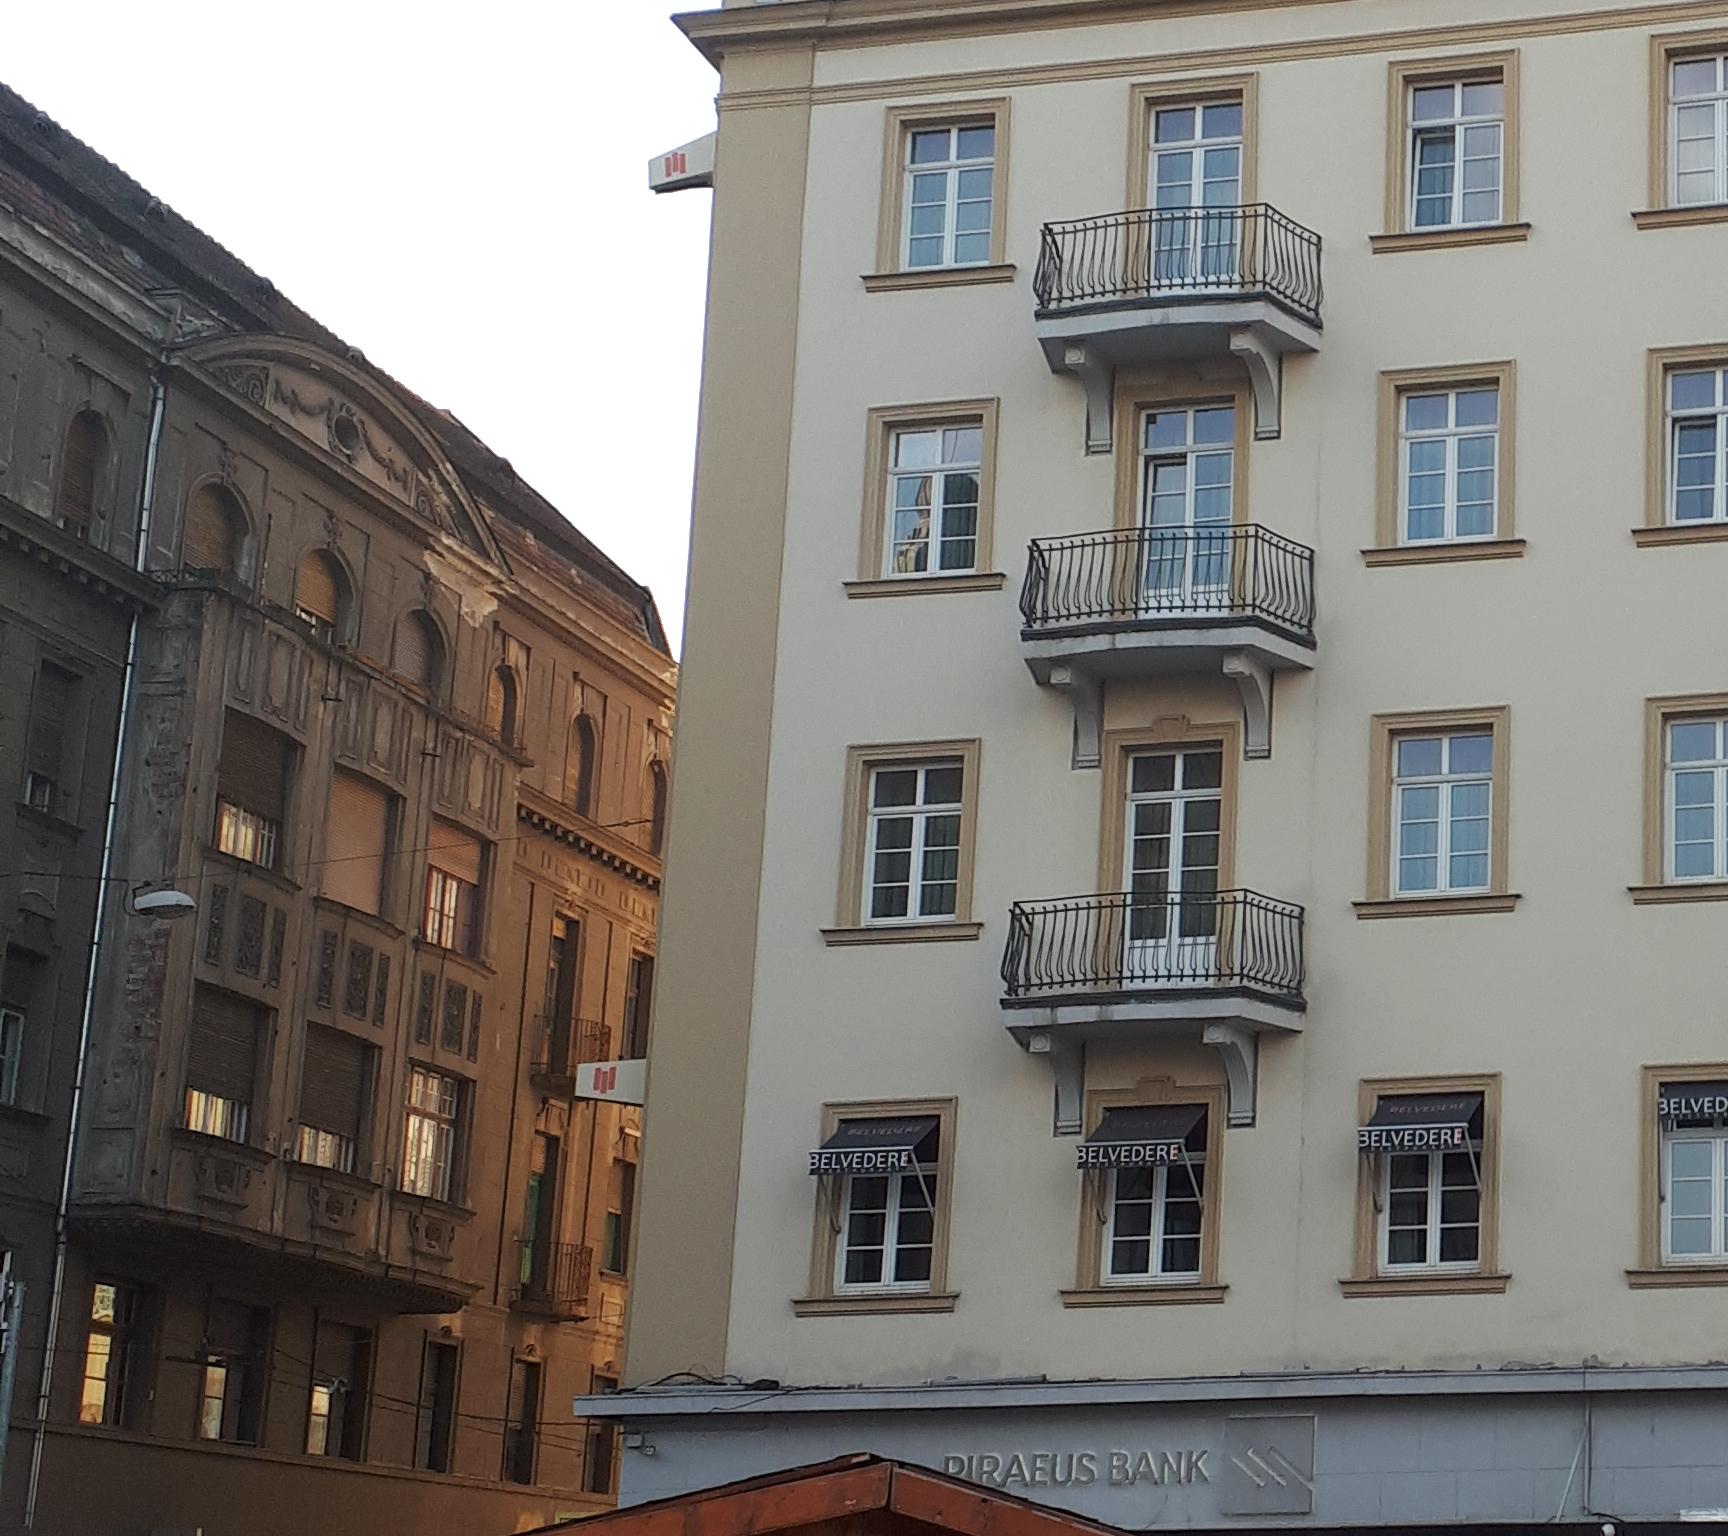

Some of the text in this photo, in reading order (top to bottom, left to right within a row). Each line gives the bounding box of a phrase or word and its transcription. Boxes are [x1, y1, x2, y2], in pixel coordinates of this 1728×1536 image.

[1359, 1128, 1462, 1148] BELVEDERE
[809, 1151, 909, 1170] BELVEDERE
[1077, 1144, 1179, 1164] BELVEDERE
[943, 1449, 1209, 1488] PIRAEUS BANK
